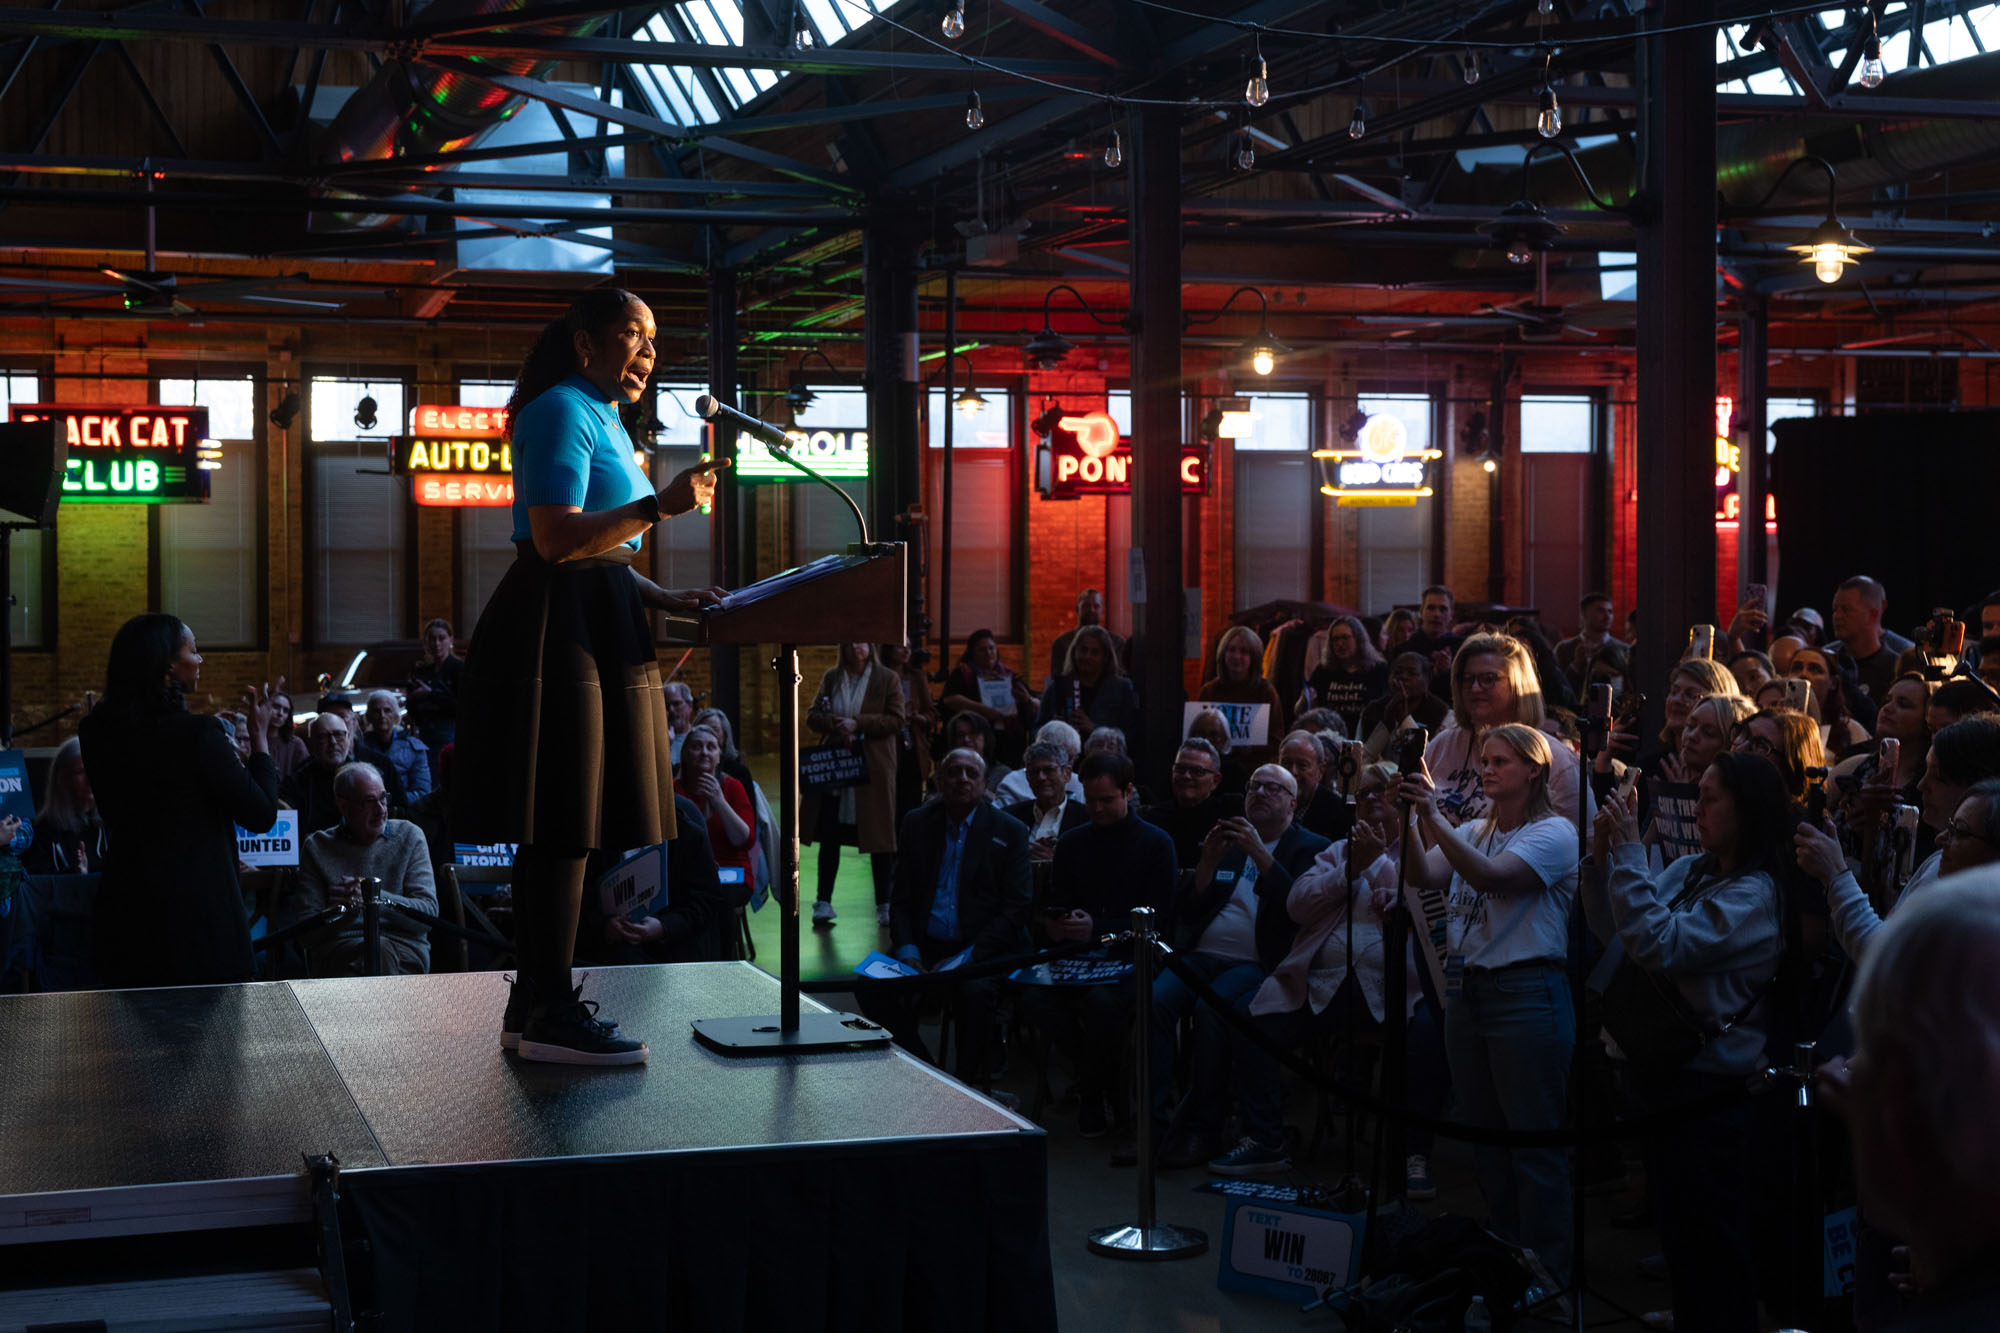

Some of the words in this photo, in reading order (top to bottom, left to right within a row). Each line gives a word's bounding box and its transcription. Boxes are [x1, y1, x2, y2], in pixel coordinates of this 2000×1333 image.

[21, 415, 121, 446] ACK
[130, 416, 189, 447] CAT
[63, 459, 159, 491] CLUB
[1248, 1212, 1281, 1226] TEXT
[1264, 1229, 1305, 1265] WIN
[1288, 1266, 1303, 1279] TO
